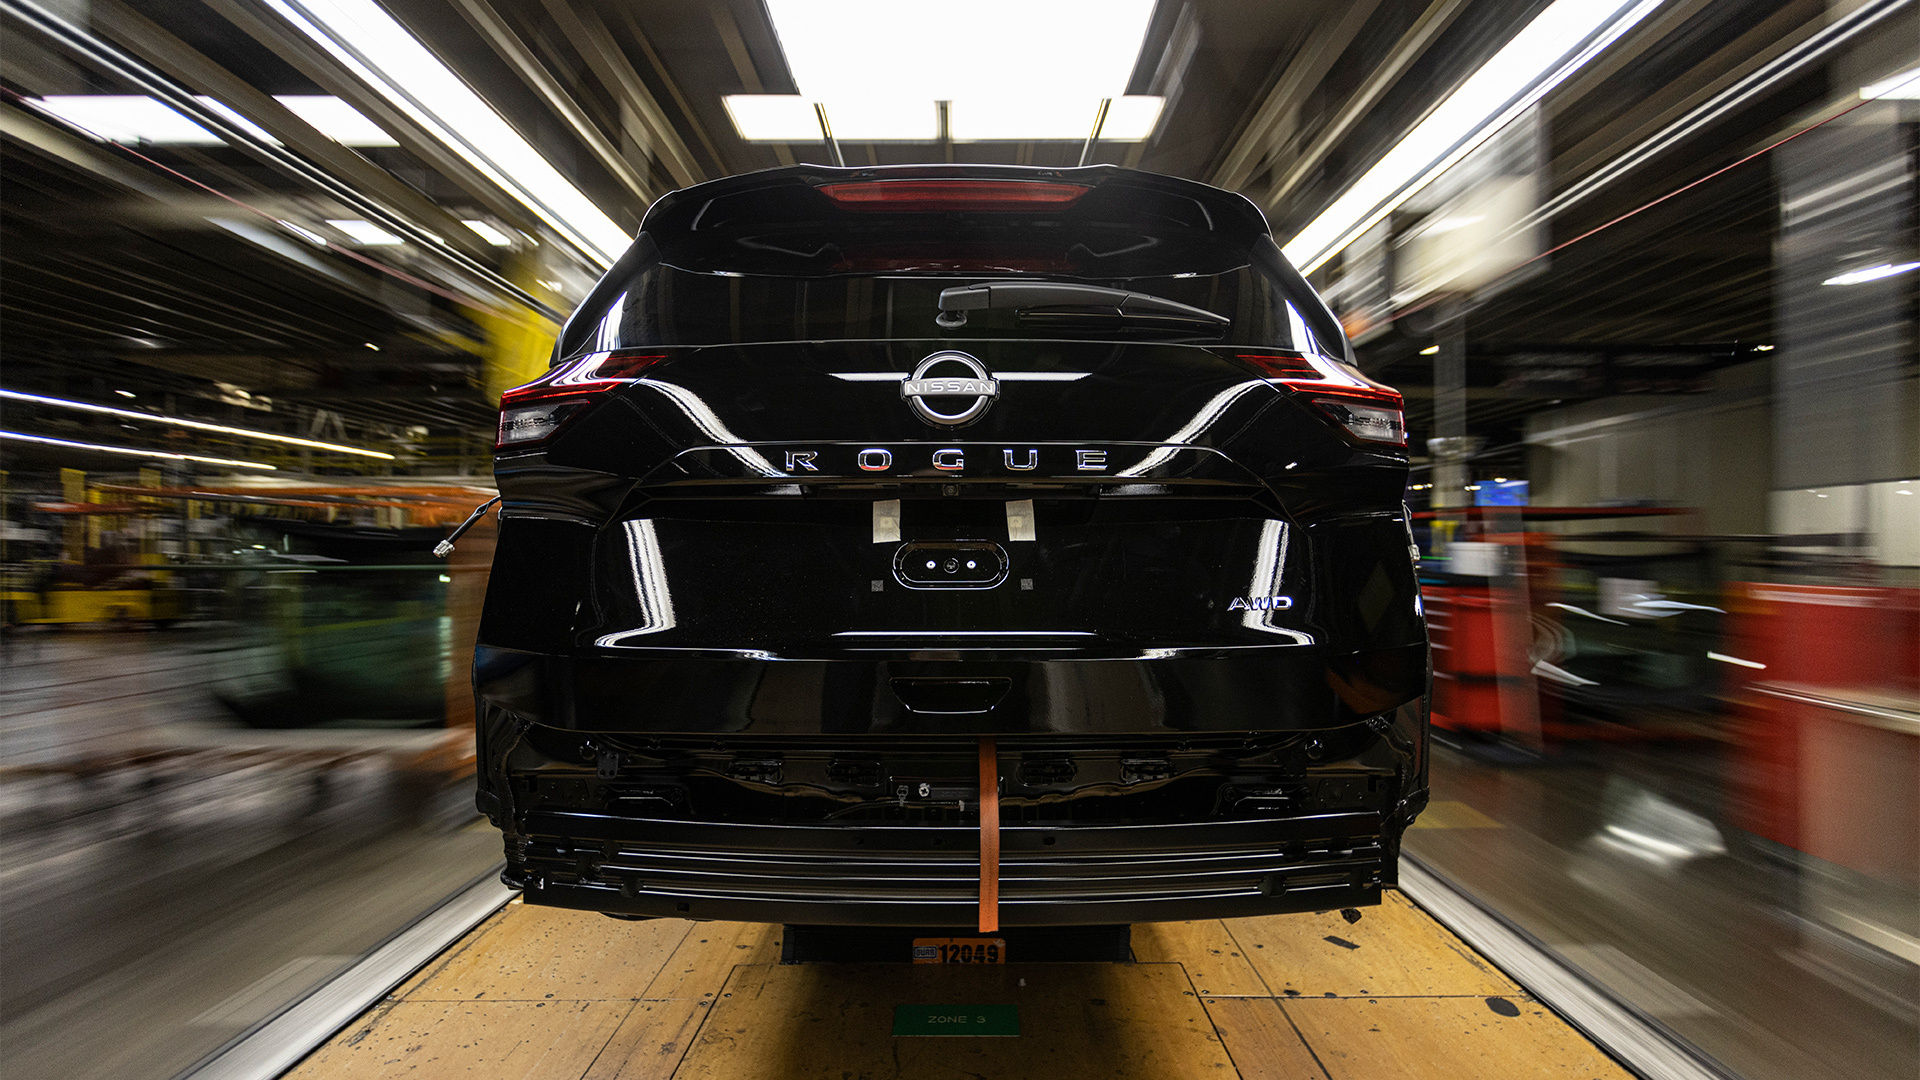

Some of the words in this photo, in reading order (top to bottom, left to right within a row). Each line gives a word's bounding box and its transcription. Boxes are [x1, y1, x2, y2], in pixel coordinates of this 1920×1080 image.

[906, 381, 993, 393] NISSAN
[784, 448, 1108, 472] ROGUE
[1226, 595, 1293, 612] AWD
[939, 944, 999, 963] 12049
[928, 1015, 968, 1024] ZONE
[976, 1015, 986, 1024] 3
